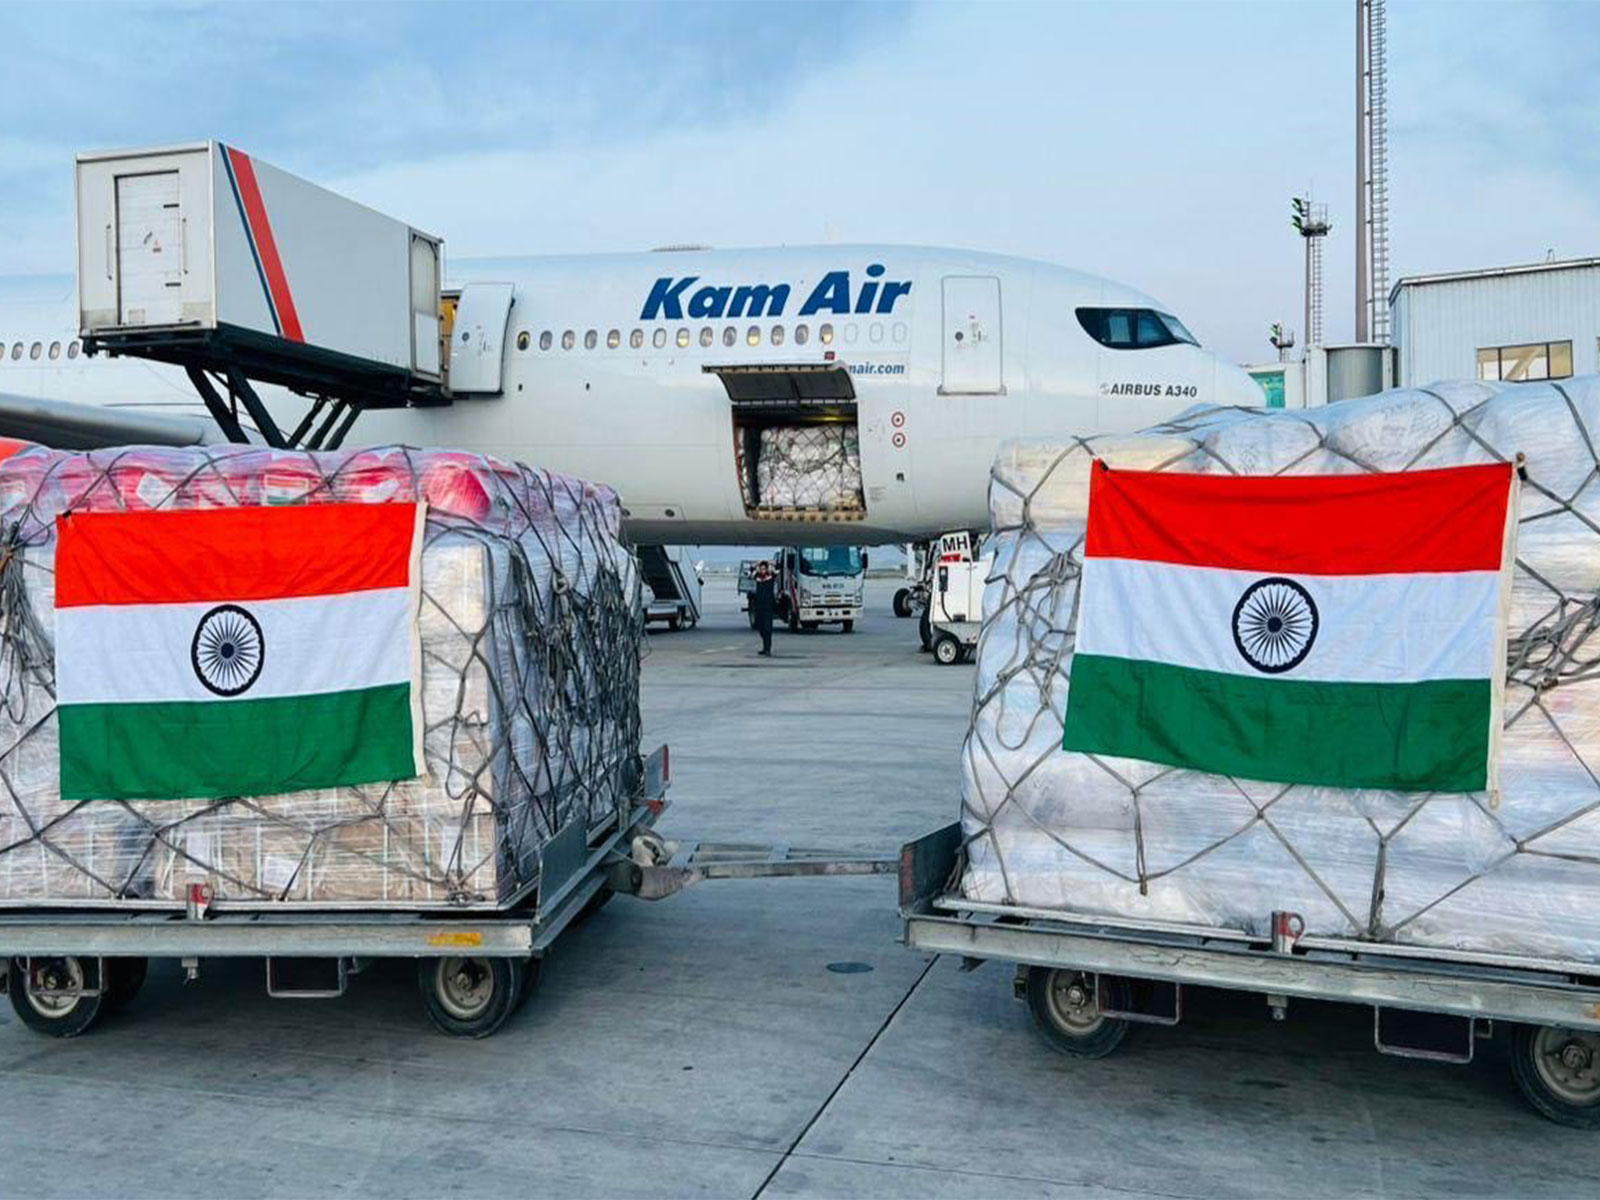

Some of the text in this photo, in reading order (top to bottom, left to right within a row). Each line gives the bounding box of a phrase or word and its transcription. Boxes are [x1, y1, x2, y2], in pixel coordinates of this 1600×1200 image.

[640, 264, 912, 320] Kam Air
[1110, 383, 1198, 398] AIRBUS A340
[942, 536, 968, 552] MH
